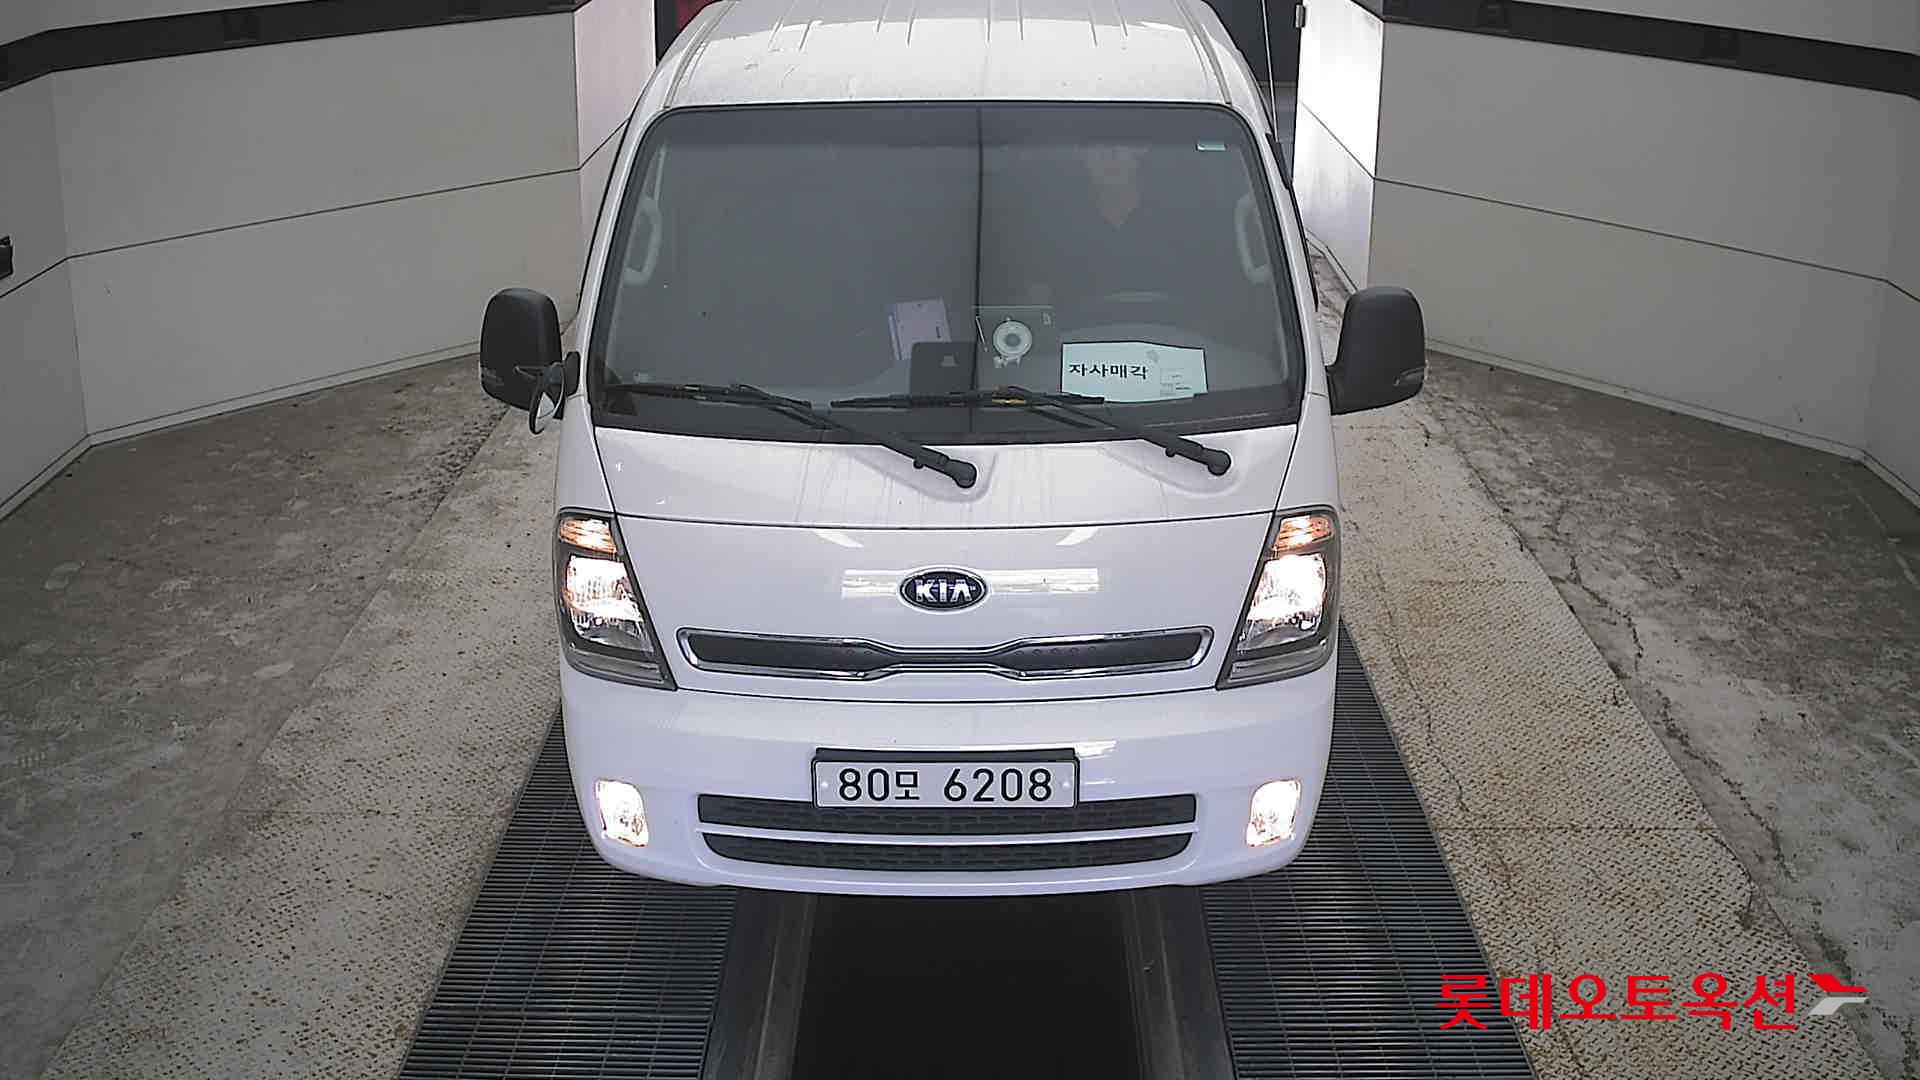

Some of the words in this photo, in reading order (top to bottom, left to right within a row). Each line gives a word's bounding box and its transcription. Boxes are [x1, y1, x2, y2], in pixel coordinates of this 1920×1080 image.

[1068, 363, 1148, 380] 자사매각
[914, 579, 973, 602] KIA
[838, 767, 920, 802] 80모
[943, 767, 1052, 802] 6208
